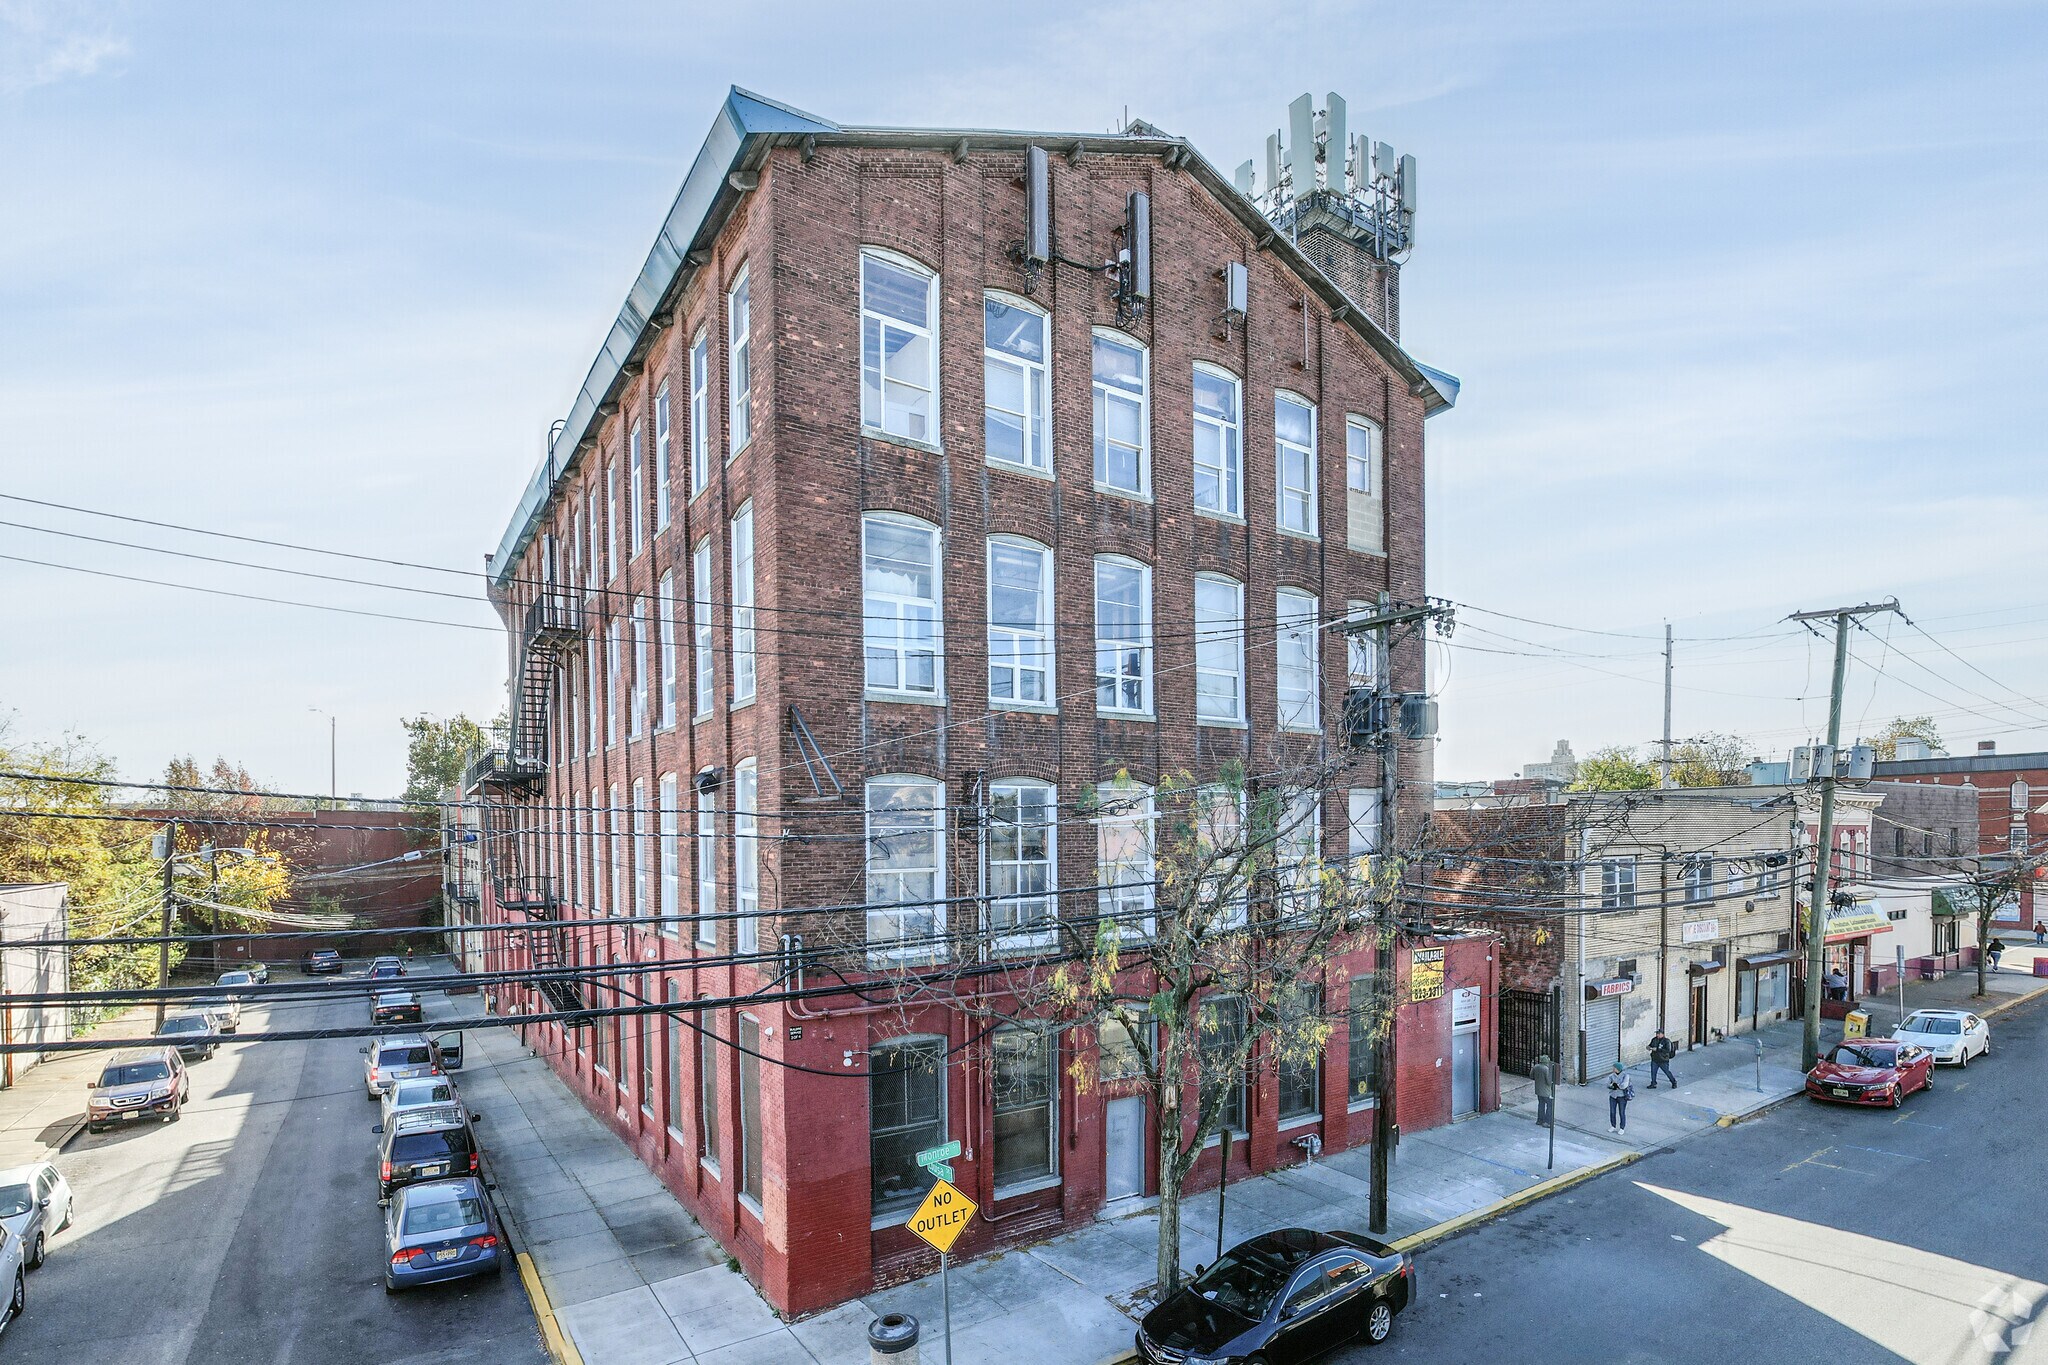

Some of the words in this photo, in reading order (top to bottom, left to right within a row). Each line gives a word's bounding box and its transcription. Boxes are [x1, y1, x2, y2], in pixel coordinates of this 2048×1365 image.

[1413, 950, 1443, 963] AVAILABLE
[1603, 981, 1631, 995] FABRICS
[921, 1146, 950, 1163] Monroe
[933, 1191, 952, 1208] NO
[917, 1207, 968, 1233] OUTLET
